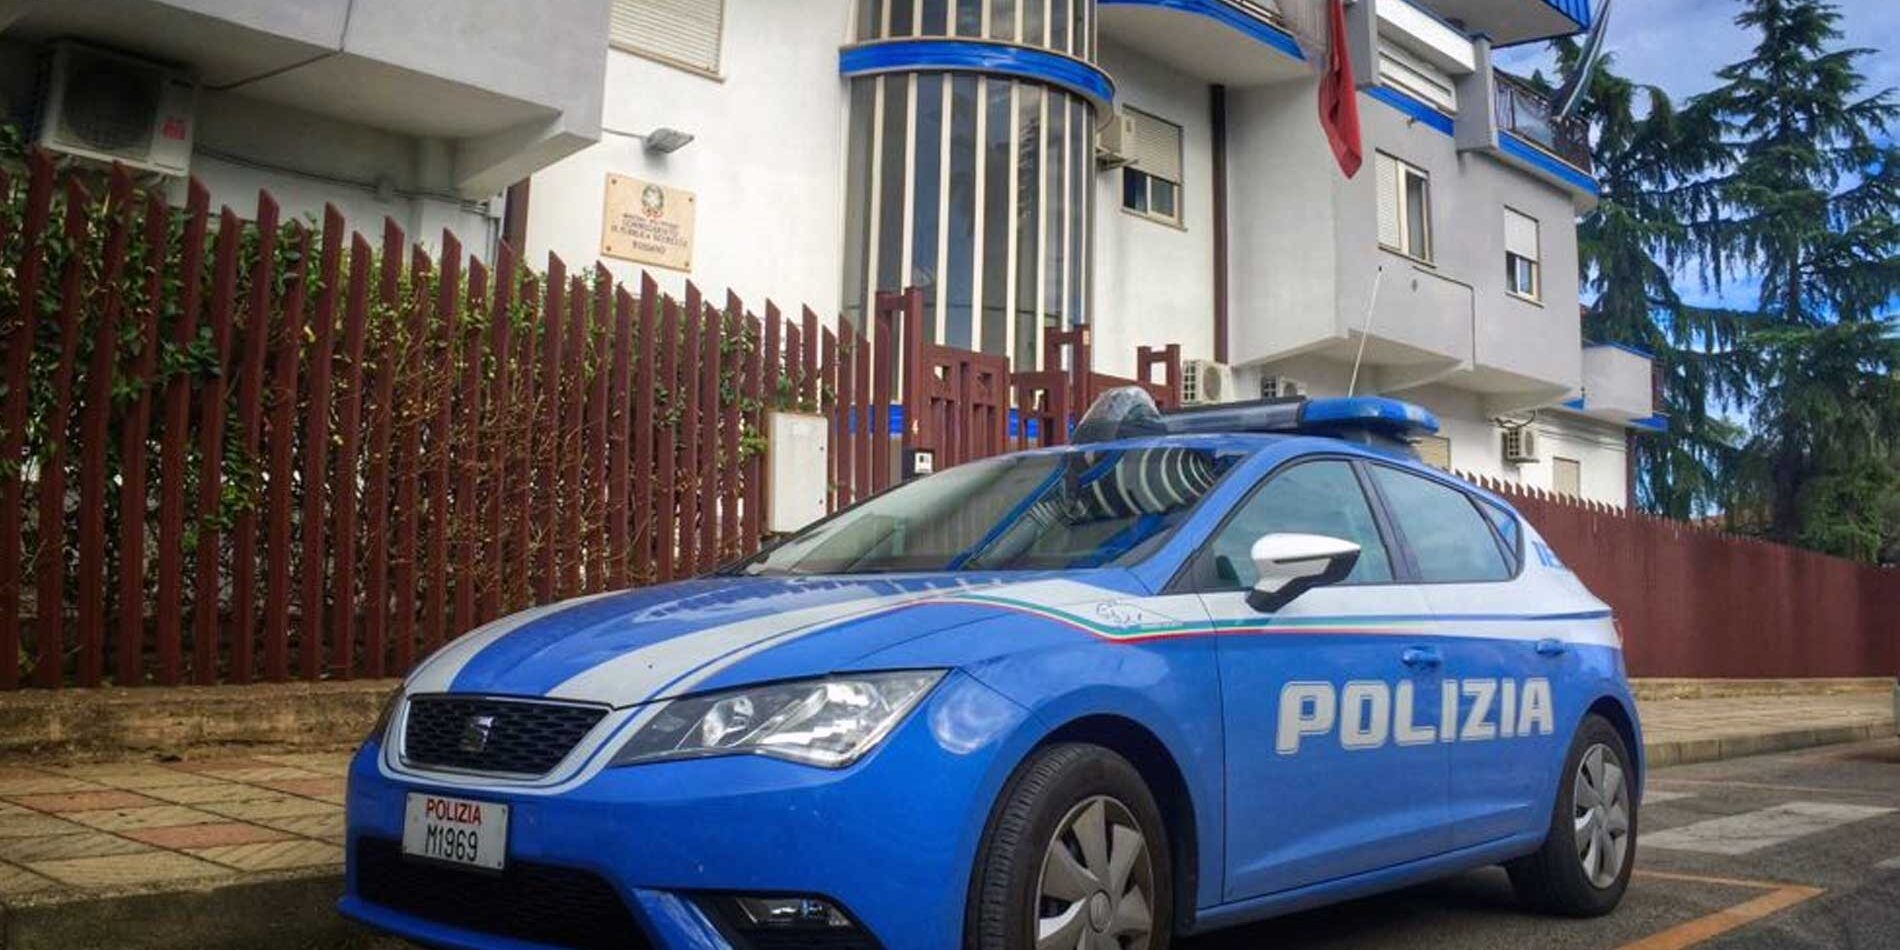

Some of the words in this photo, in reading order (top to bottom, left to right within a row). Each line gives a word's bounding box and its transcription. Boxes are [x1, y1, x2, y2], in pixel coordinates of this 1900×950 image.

[1275, 677, 1554, 755] POLIZIA
[426, 798, 482, 826] POLIZIA
[425, 823, 478, 862] M1969
